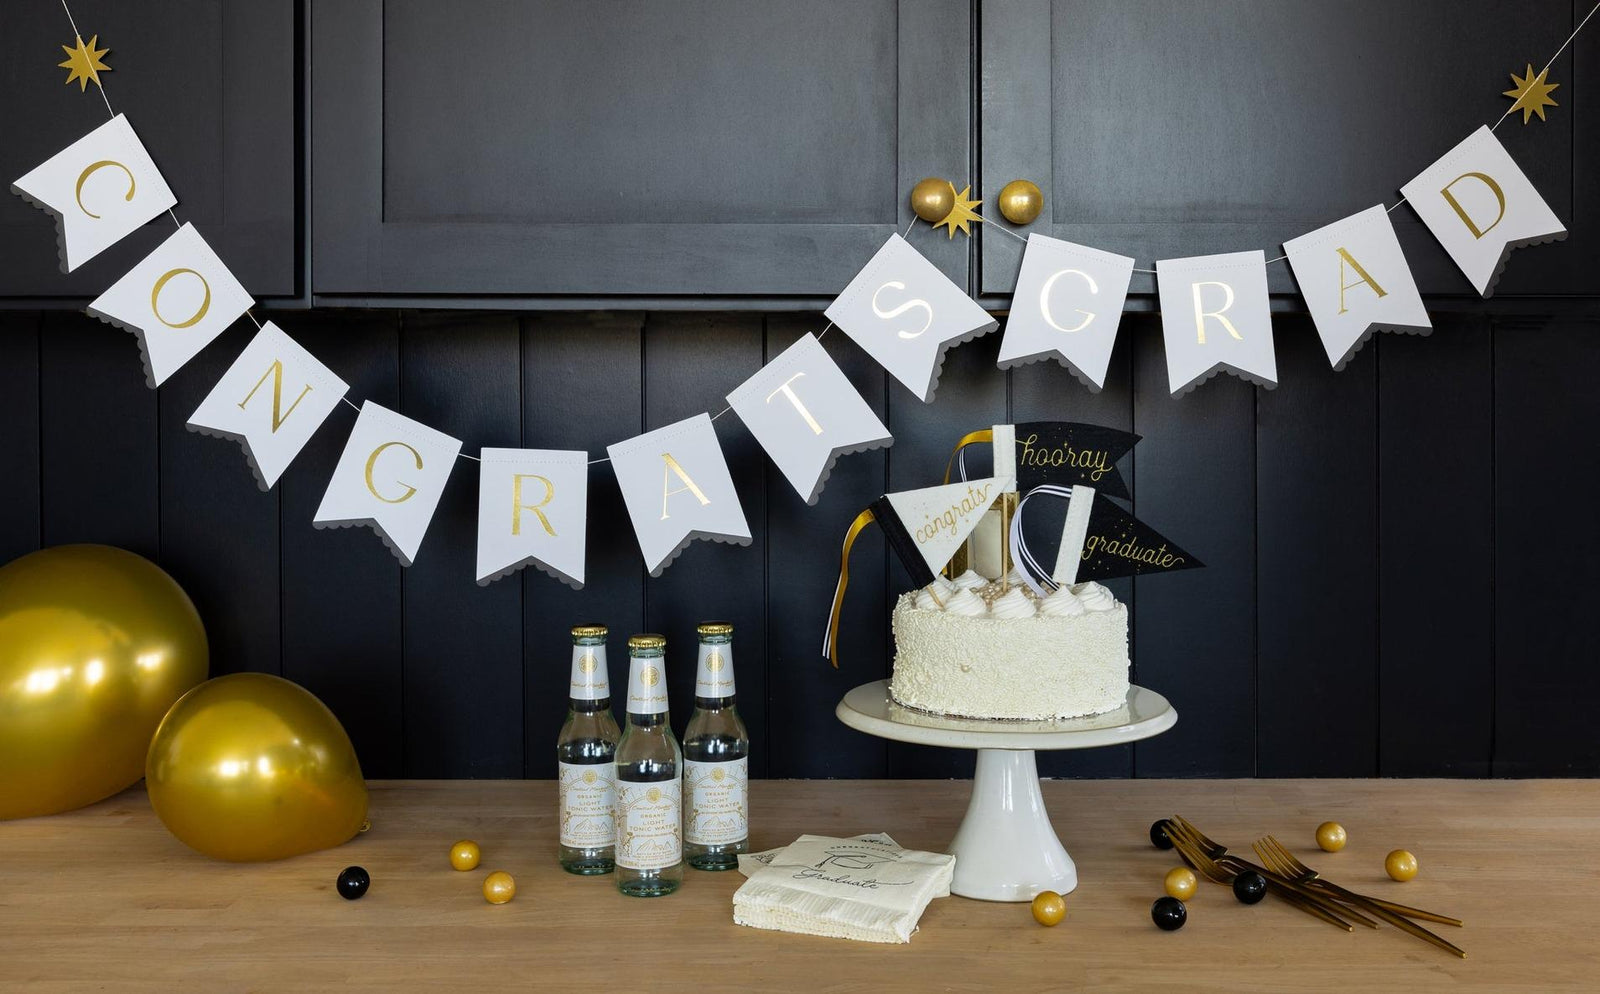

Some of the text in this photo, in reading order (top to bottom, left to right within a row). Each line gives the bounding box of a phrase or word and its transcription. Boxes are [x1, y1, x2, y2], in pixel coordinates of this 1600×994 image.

[1015, 433, 1114, 482] hooray
[915, 483, 993, 545] congrats
[1082, 532, 1185, 569] graduate
[655, 823, 677, 831] WATER
[792, 864, 914, 890] Graduate
